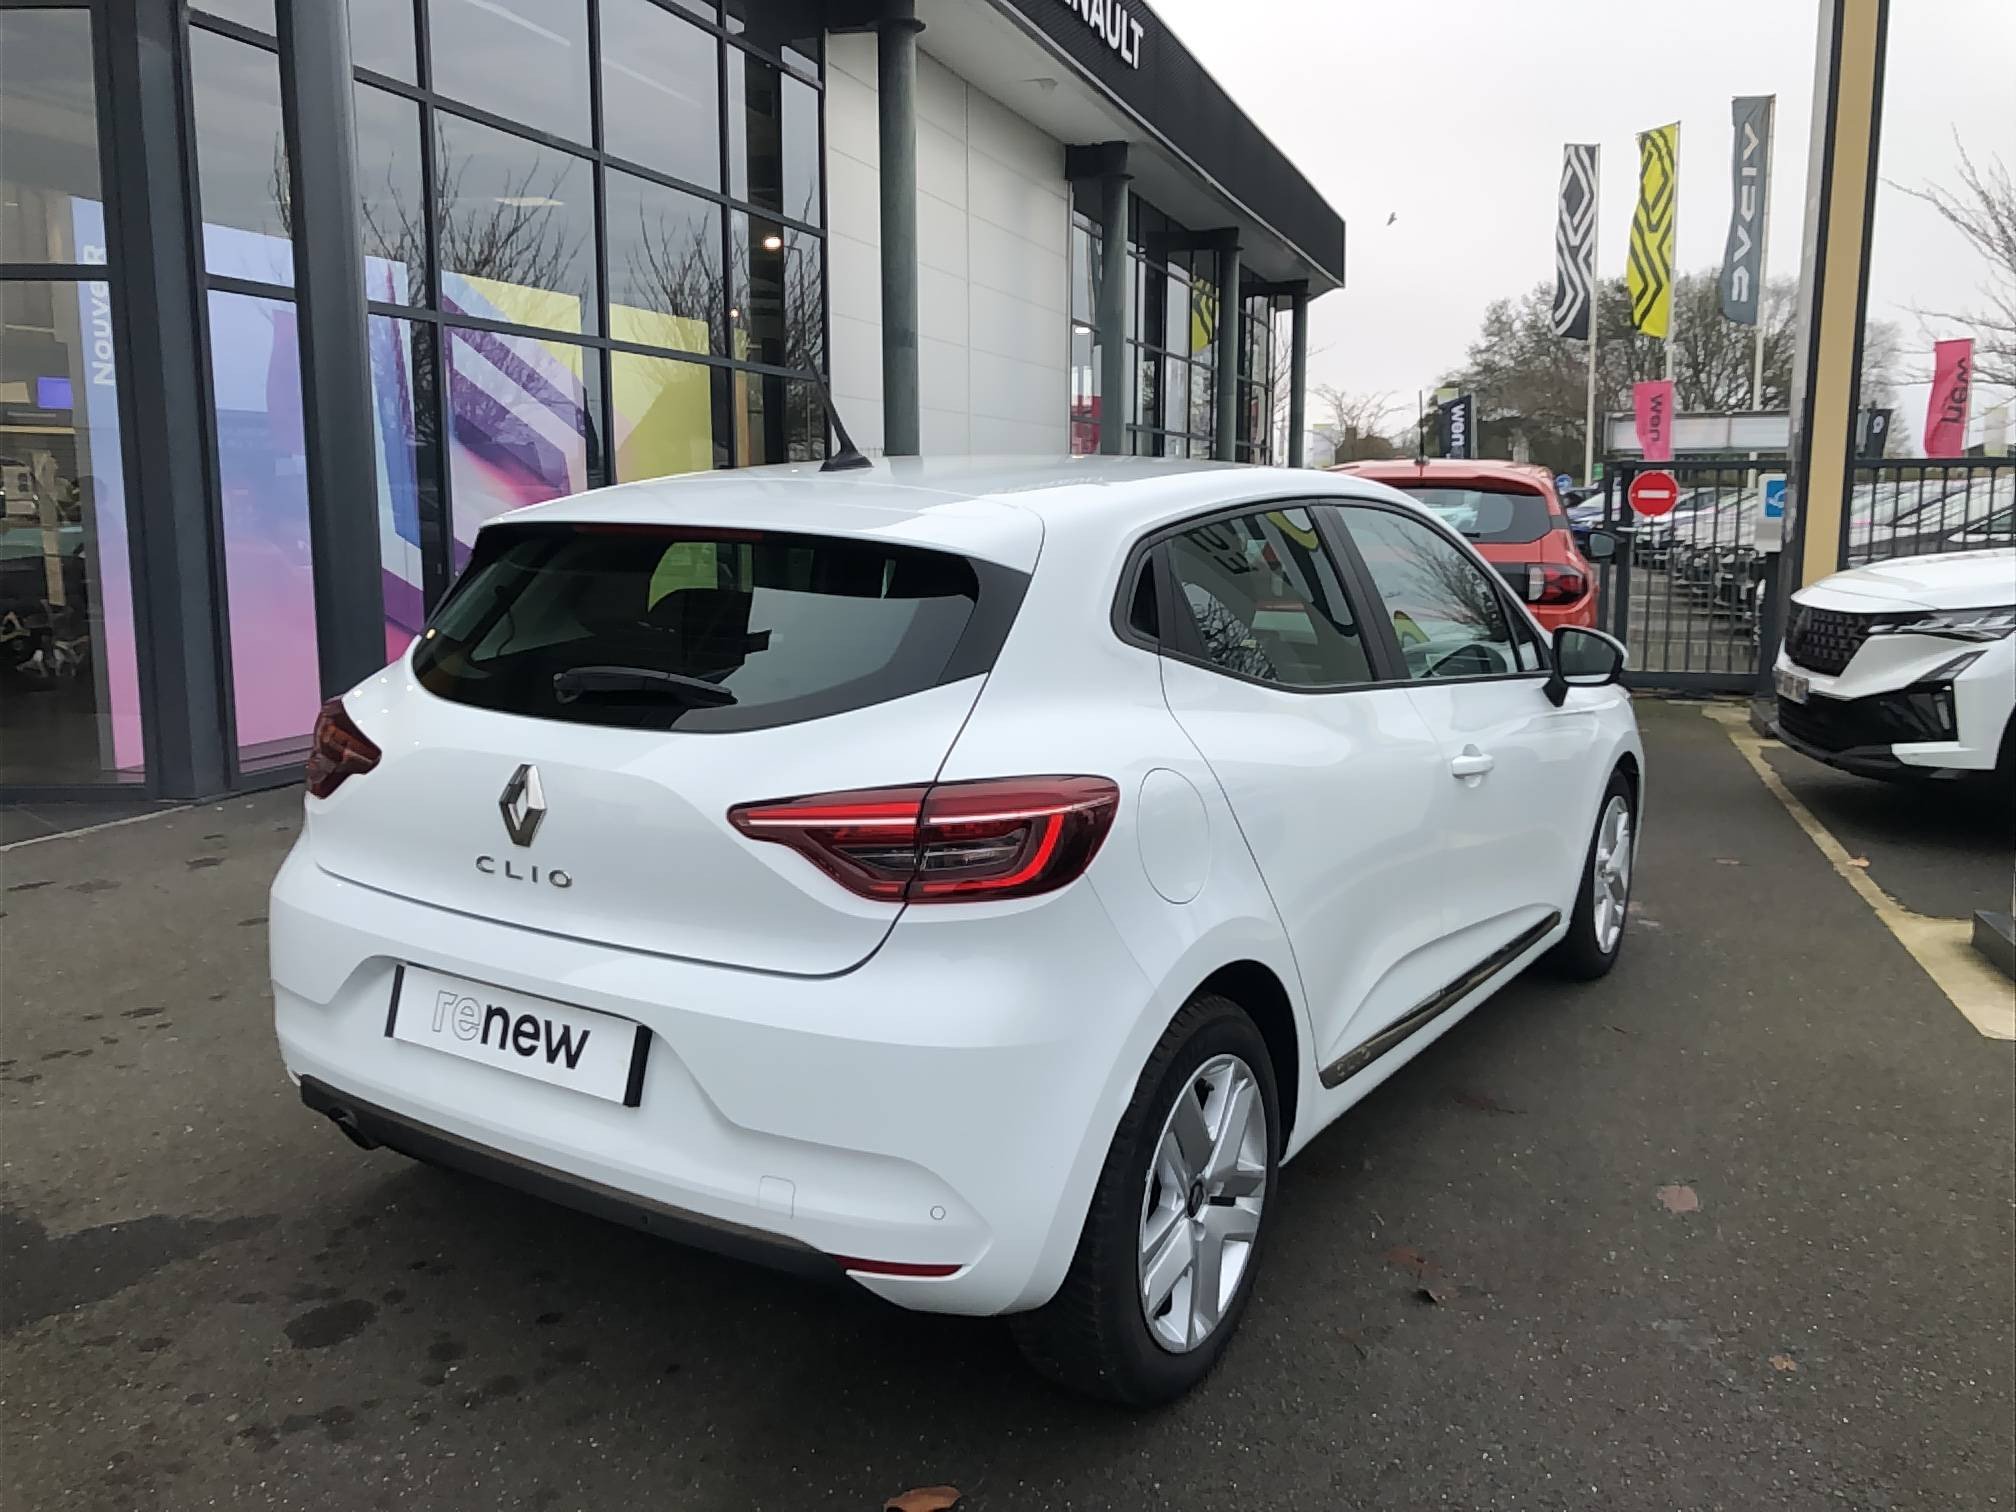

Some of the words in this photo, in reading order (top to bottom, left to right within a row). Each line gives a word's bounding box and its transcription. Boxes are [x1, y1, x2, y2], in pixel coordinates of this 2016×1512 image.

[89, 281, 116, 386] Nouve
[475, 855, 573, 888] CLIO
[431, 989, 591, 1070] renew
